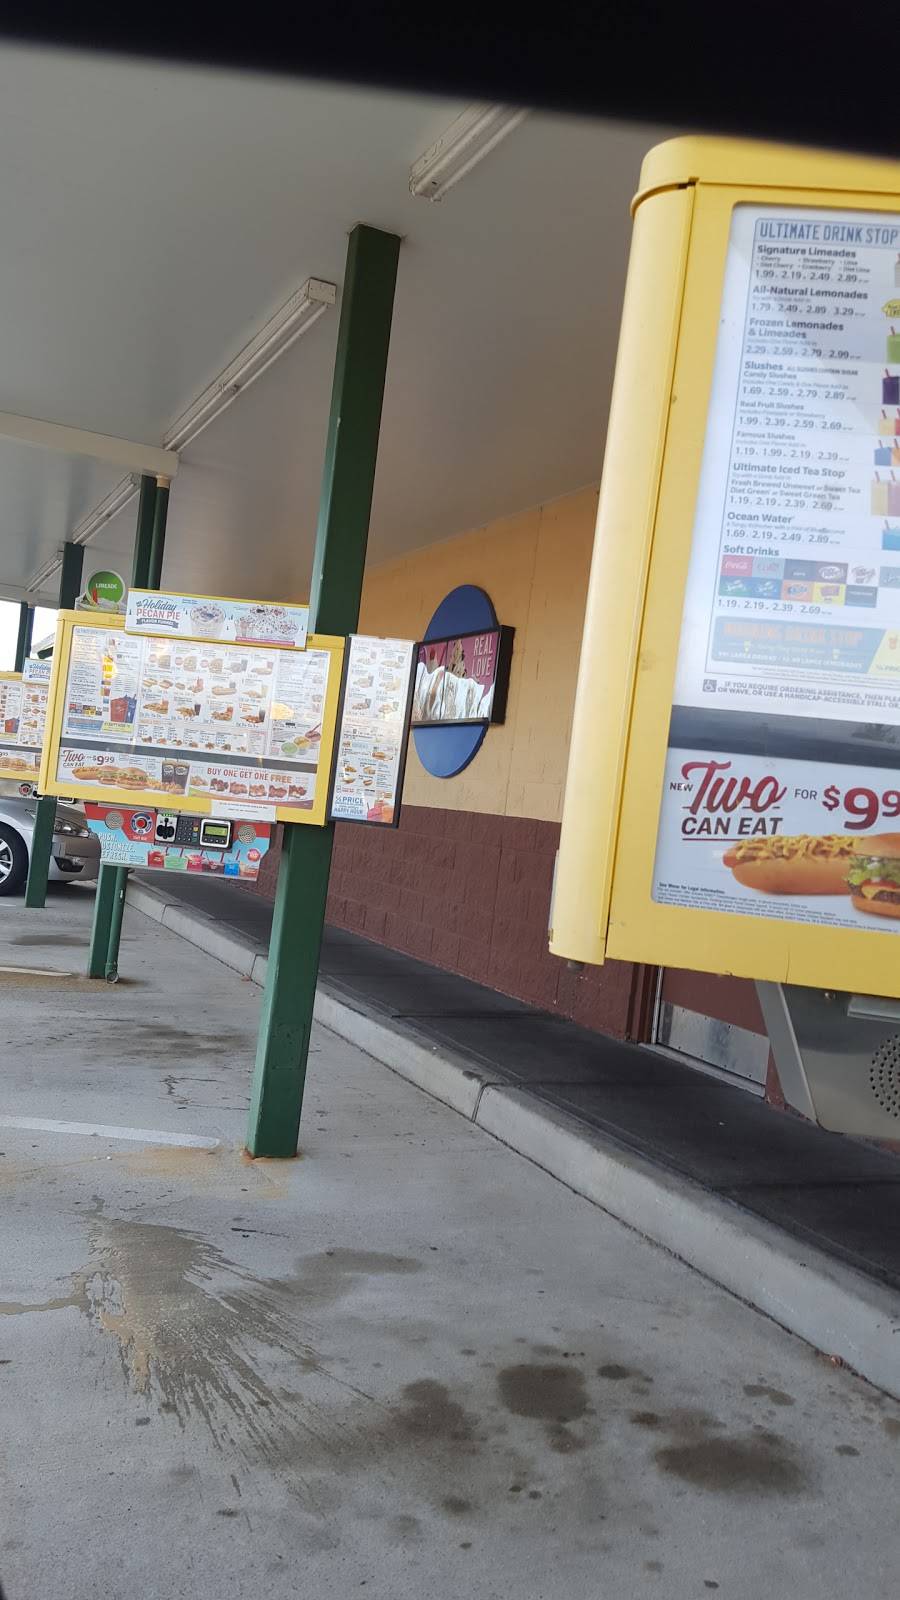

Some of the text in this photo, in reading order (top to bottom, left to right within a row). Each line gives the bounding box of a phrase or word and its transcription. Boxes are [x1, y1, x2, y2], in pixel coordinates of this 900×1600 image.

[760, 222, 899, 245] ULTIMATE DRINK STOP
[757, 244, 857, 258] Signature Limeades
[755, 269, 775, 279] 1.99
[781, 270, 802, 280] 2.19
[810, 271, 830, 281] 2.49
[752, 285, 869, 300] All-Natural Lemonades
[749, 317, 844, 331] Frozen Lemonades
[758, 328, 807, 339] Limeades
[829, 350, 849, 360] 2.99
[744, 361, 783, 371] Slushes
[769, 371, 797, 380] Slushes
[776, 401, 804, 410] Slushes
[736, 447, 755, 455] 1.19
[790, 450, 811, 458] 2.19
[733, 462, 777, 473] Ultimate
[779, 464, 800, 474] Iced
[802, 466, 820, 476] Tea
[821, 467, 846, 479] Stop
[730, 496, 749, 505] 1.19
[756, 497, 776, 505] 2.19
[727, 512, 793, 523] Ocean Water
[752, 530, 773, 539] 2.19
[723, 544, 779, 556] Soft Drinks
[141, 599, 177, 611] Holiday
[744, 600, 764, 610] 2.19
[136, 608, 181, 620] PECAN PIE
[473, 634, 493, 656] REAL
[471, 657, 491, 678] LOVE
[207, 767, 221, 775] BUY
[223, 769, 238, 777] ONE
[239, 771, 253, 779] GET
[254, 772, 269, 780] ONE
[270, 774, 293, 783] FREE
[669, 782, 694, 793] NEW
[681, 760, 788, 815] Two
[794, 788, 818, 801] FOR
[342, 796, 364, 804] PRICE
[681, 817, 783, 836] CAN EAT
